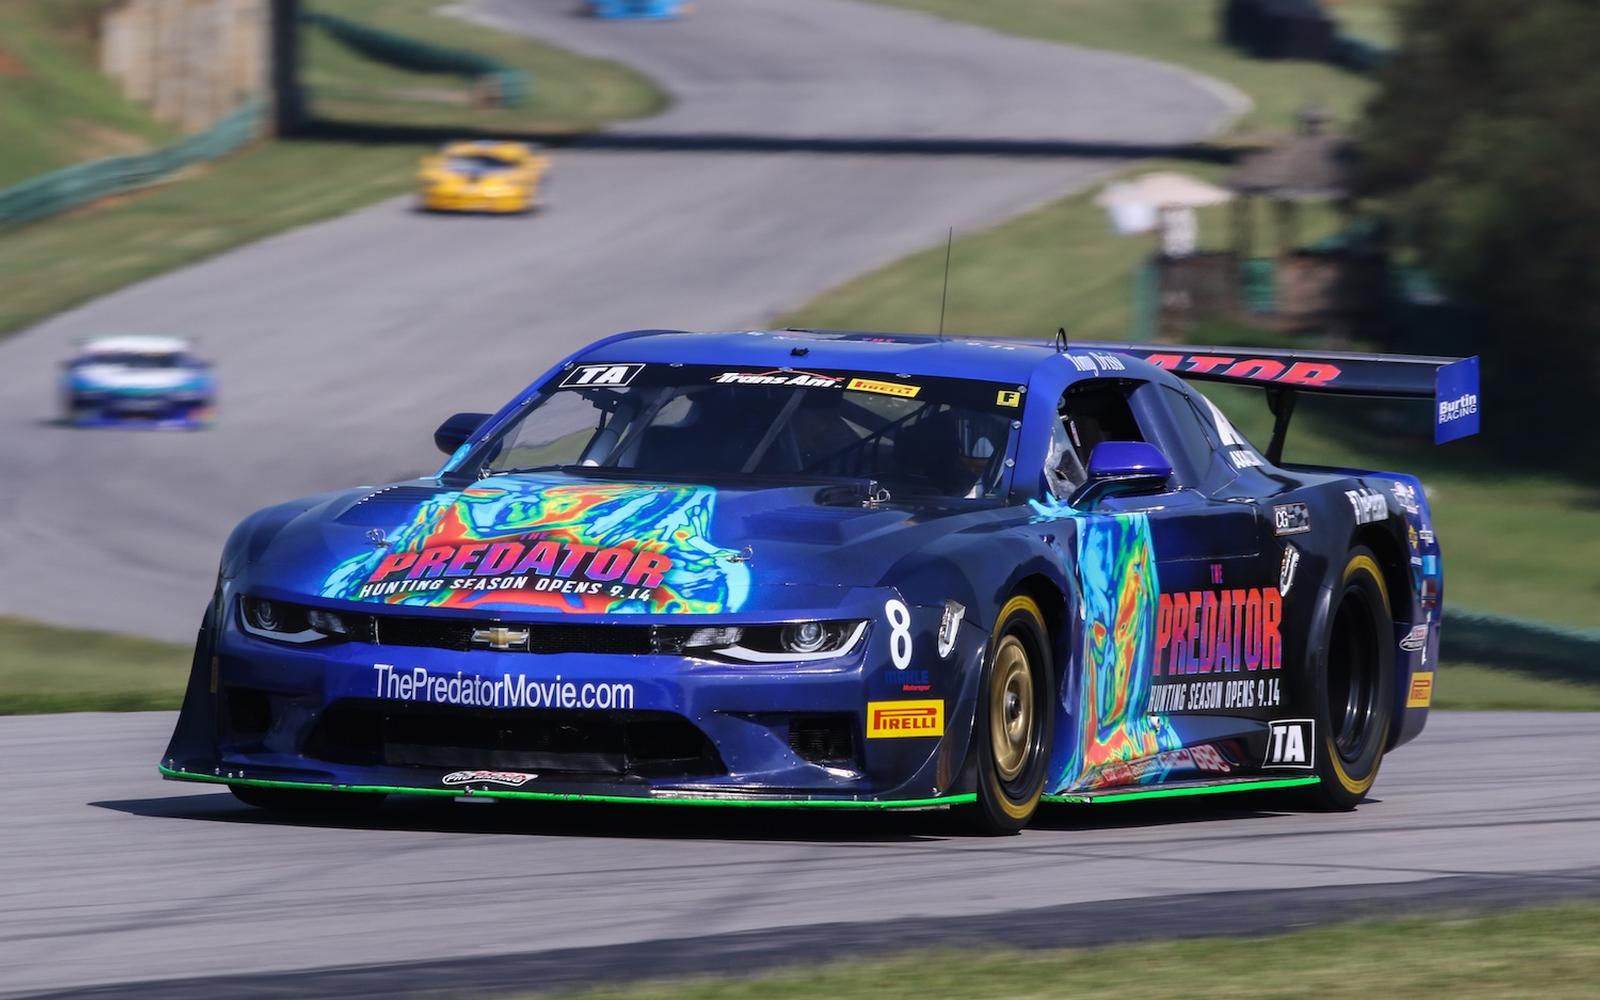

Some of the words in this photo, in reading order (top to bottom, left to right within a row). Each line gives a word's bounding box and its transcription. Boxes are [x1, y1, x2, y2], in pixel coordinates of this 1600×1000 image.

[576, 366, 629, 384] TA
[716, 372, 789, 385] Trans
[784, 375, 836, 388] Am
[1145, 353, 1341, 387] ATOR
[1003, 392, 1015, 403] F
[1439, 393, 1477, 415] Burtin
[1439, 404, 1477, 425] RACING
[520, 531, 549, 541] THE
[368, 541, 674, 589] PREDATOR
[358, 579, 444, 599] HUNTING
[450, 576, 528, 591] SEASON
[535, 578, 602, 595] OPENS
[610, 585, 651, 602] 9.14
[885, 599, 912, 670] 8
[1152, 587, 1282, 677] PREDATOR
[373, 663, 634, 709] ThePredatorMovie.com
[1147, 683, 1187, 713] HUNTING
[1187, 681, 1223, 710] SEASON
[1225, 679, 1254, 709] OPENS
[1257, 678, 1280, 707] 9.14
[873, 707, 938, 730] PIRELLI
[1272, 725, 1306, 763] TA
